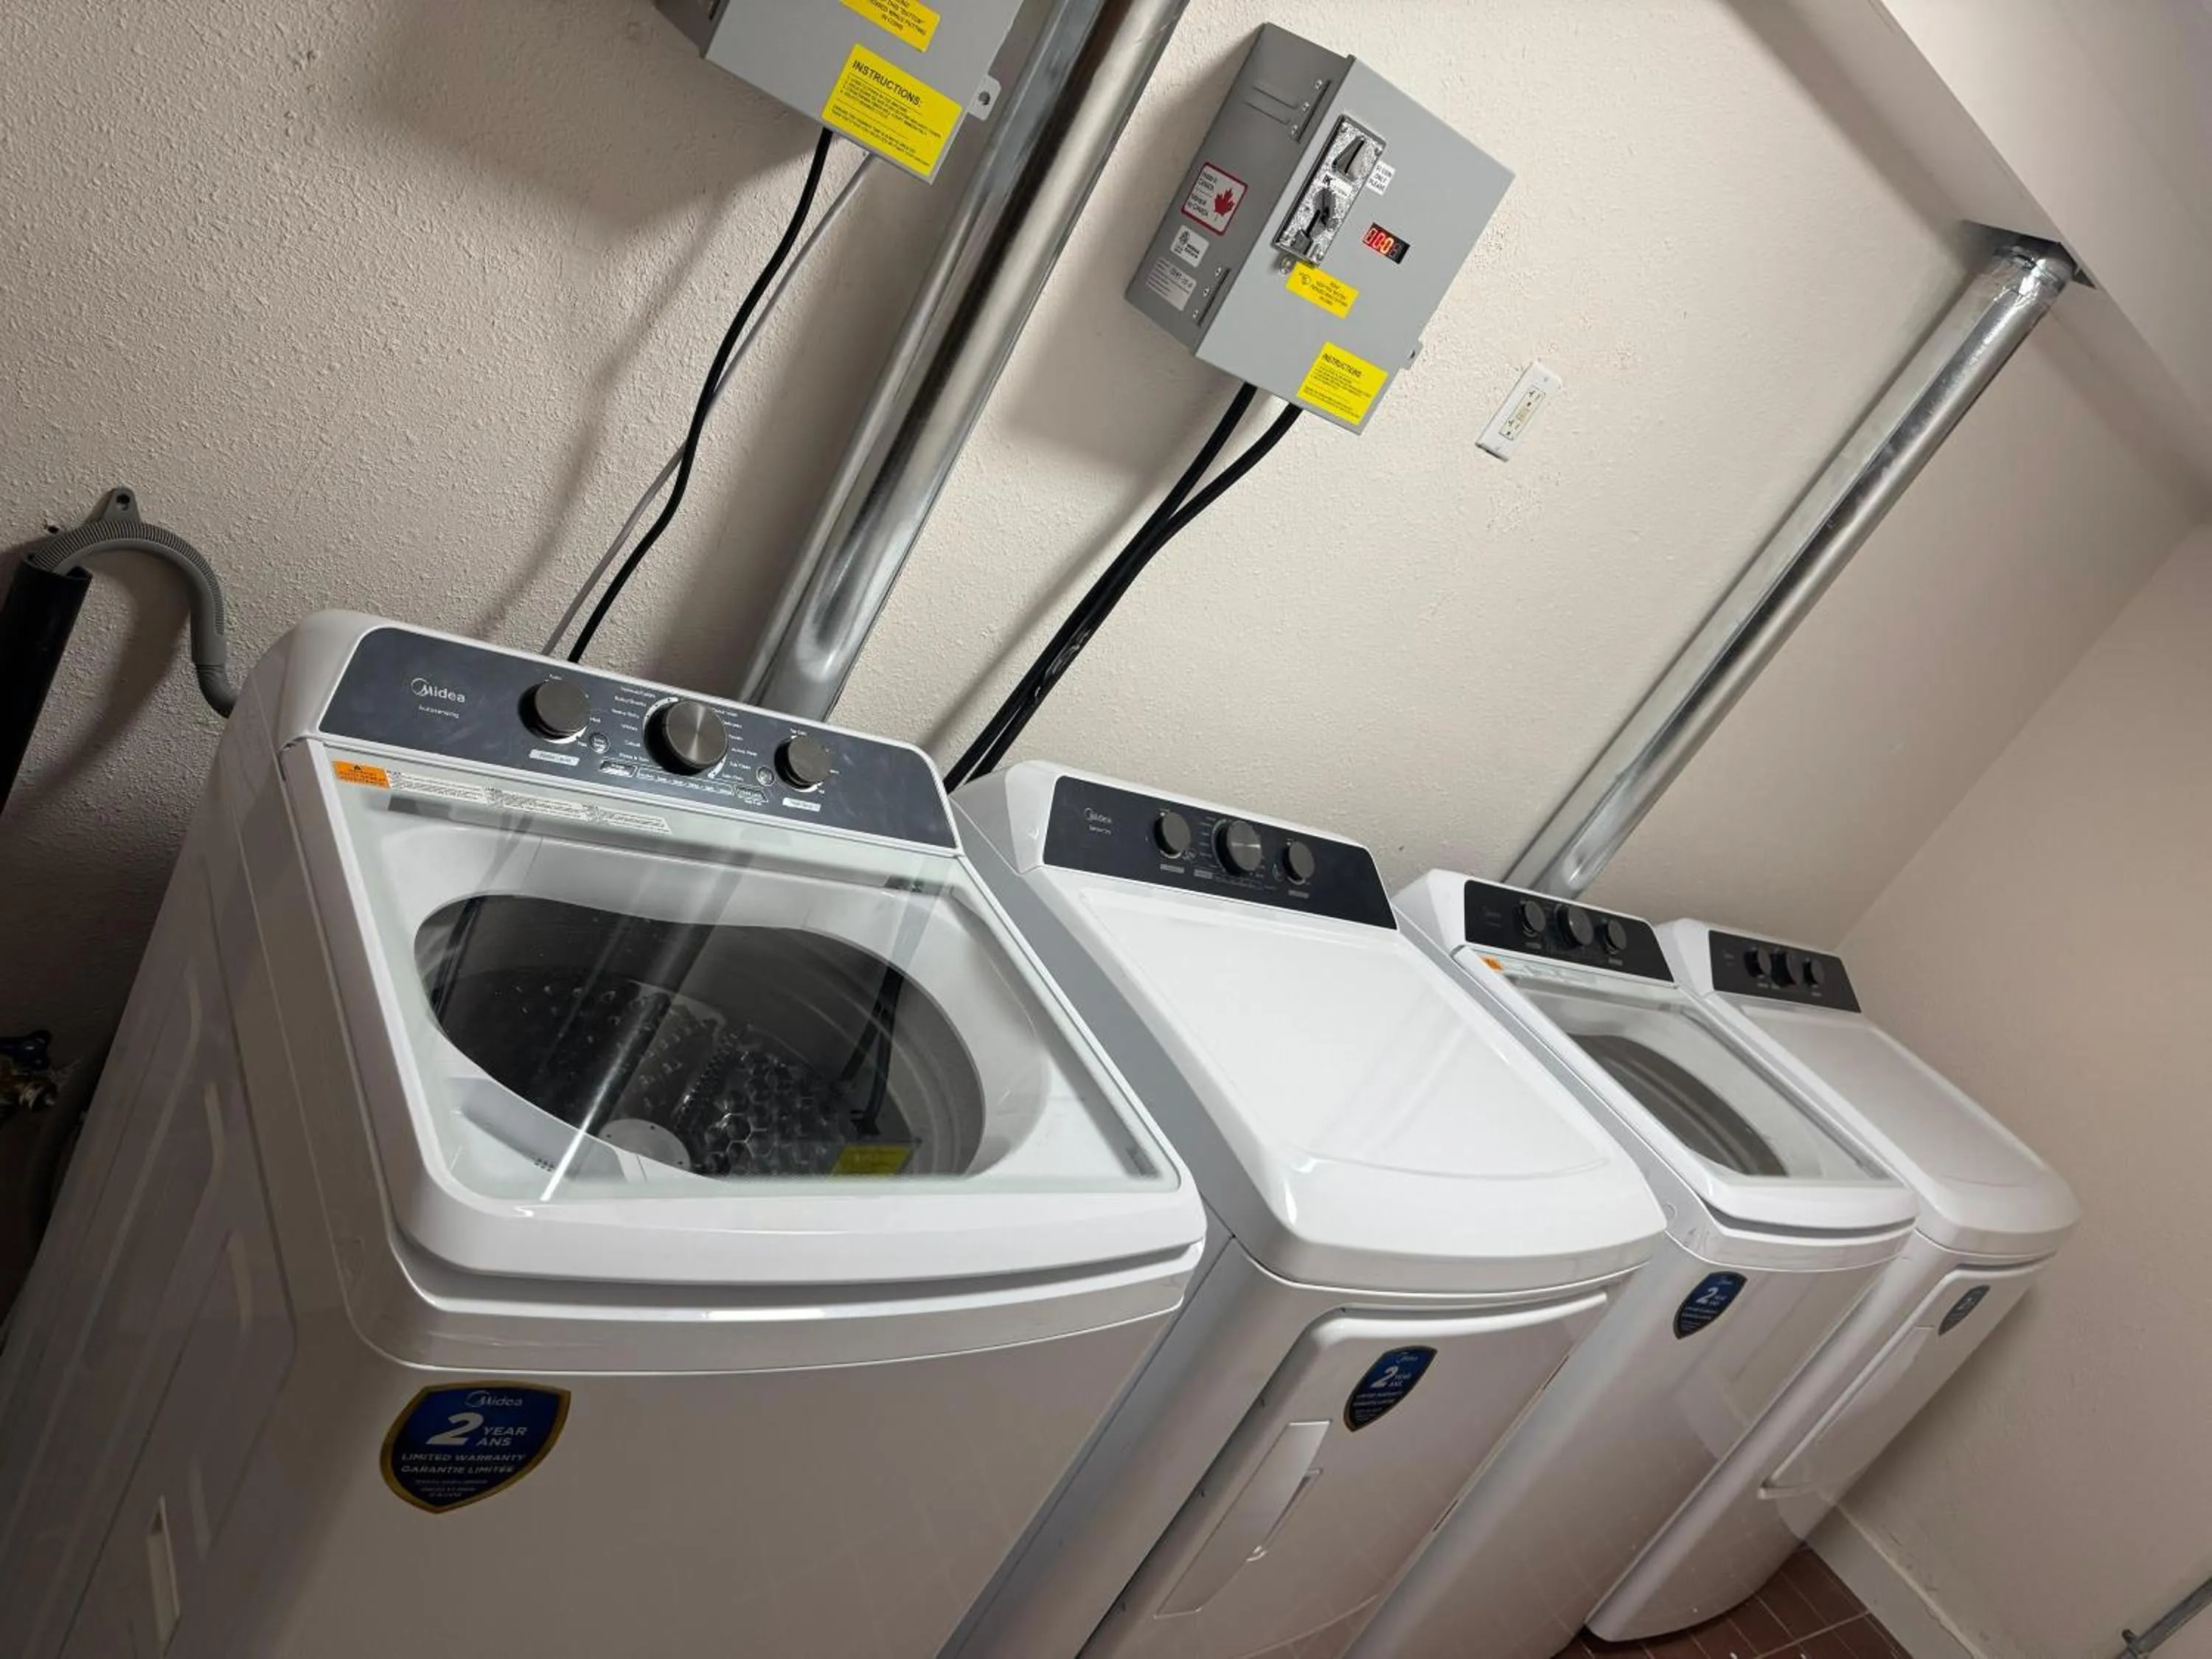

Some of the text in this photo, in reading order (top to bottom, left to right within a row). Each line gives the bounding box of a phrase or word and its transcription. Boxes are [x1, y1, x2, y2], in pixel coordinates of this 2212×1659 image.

[411, 678, 465, 703] Midea
[1696, 1287, 1719, 1304] 2
[1370, 1366, 1399, 1388] 2
[465, 1390, 523, 1408] Midea
[425, 1412, 527, 1446] 2 YEAR
[476, 1438, 512, 1447] ANS
[401, 1453, 526, 1462] LIMITED WARRANTY
[400, 1464, 465, 1474] GARANTIE
